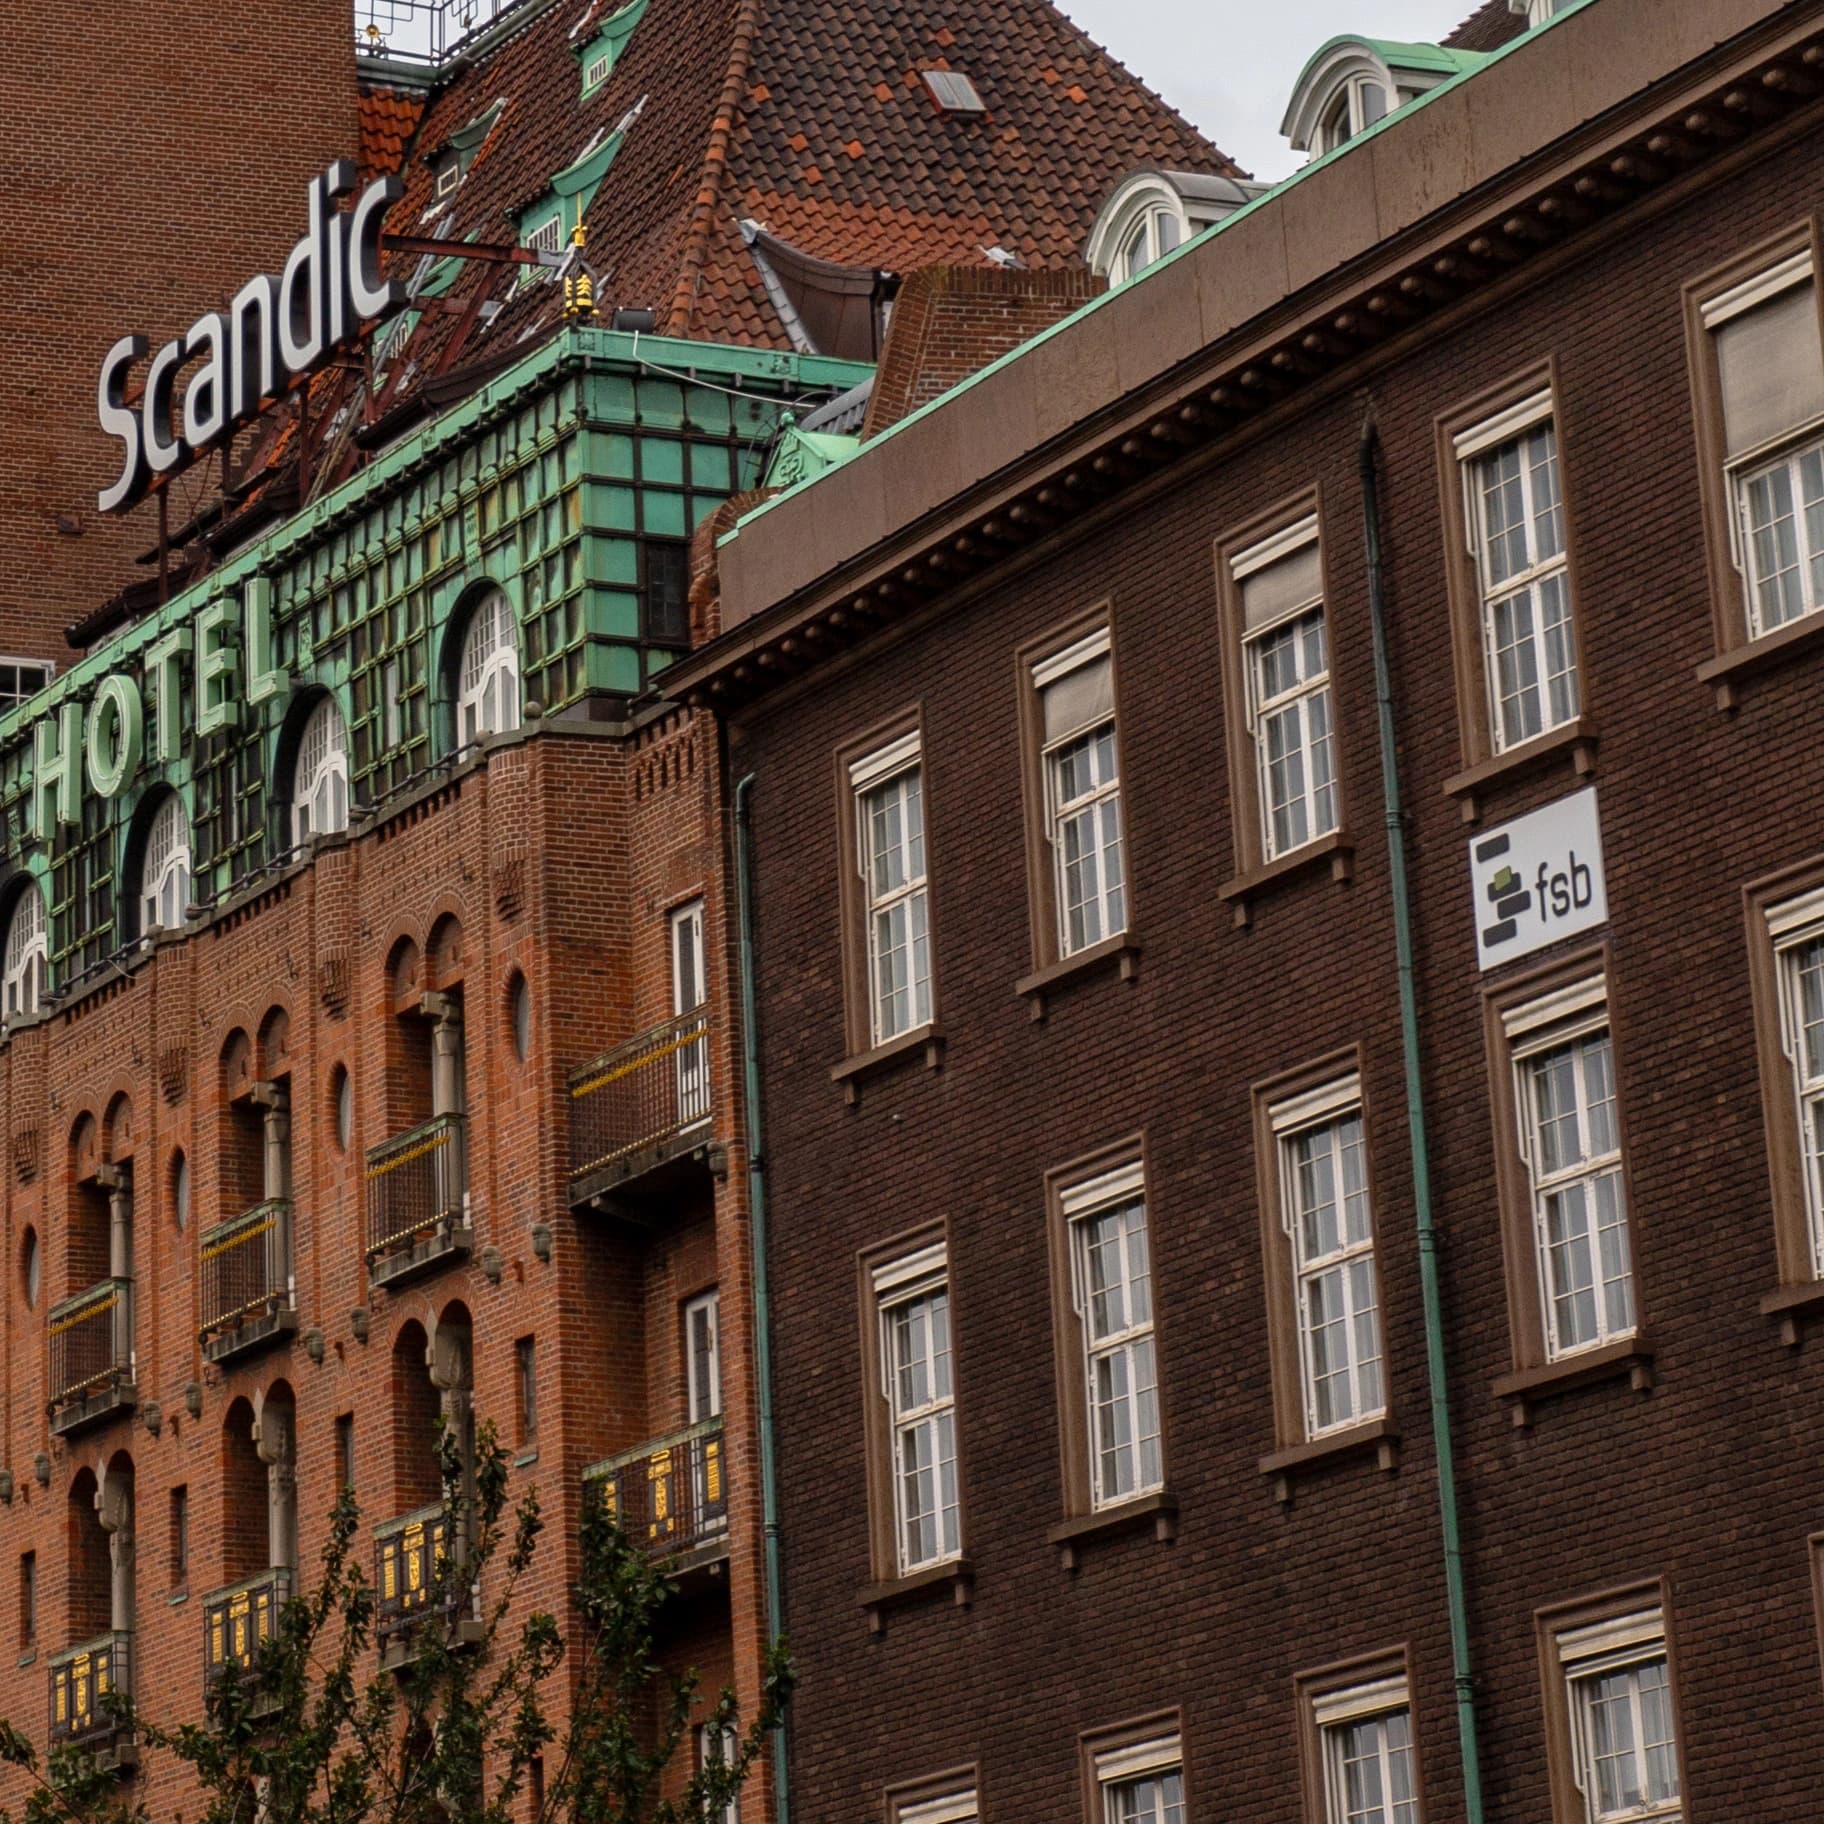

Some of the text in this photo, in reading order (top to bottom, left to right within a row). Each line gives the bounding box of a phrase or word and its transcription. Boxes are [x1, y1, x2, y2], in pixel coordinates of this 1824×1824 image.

[98, 158, 407, 514] Scandic
[33, 578, 288, 840] HOTEL
[1535, 851, 1592, 922] fsb
